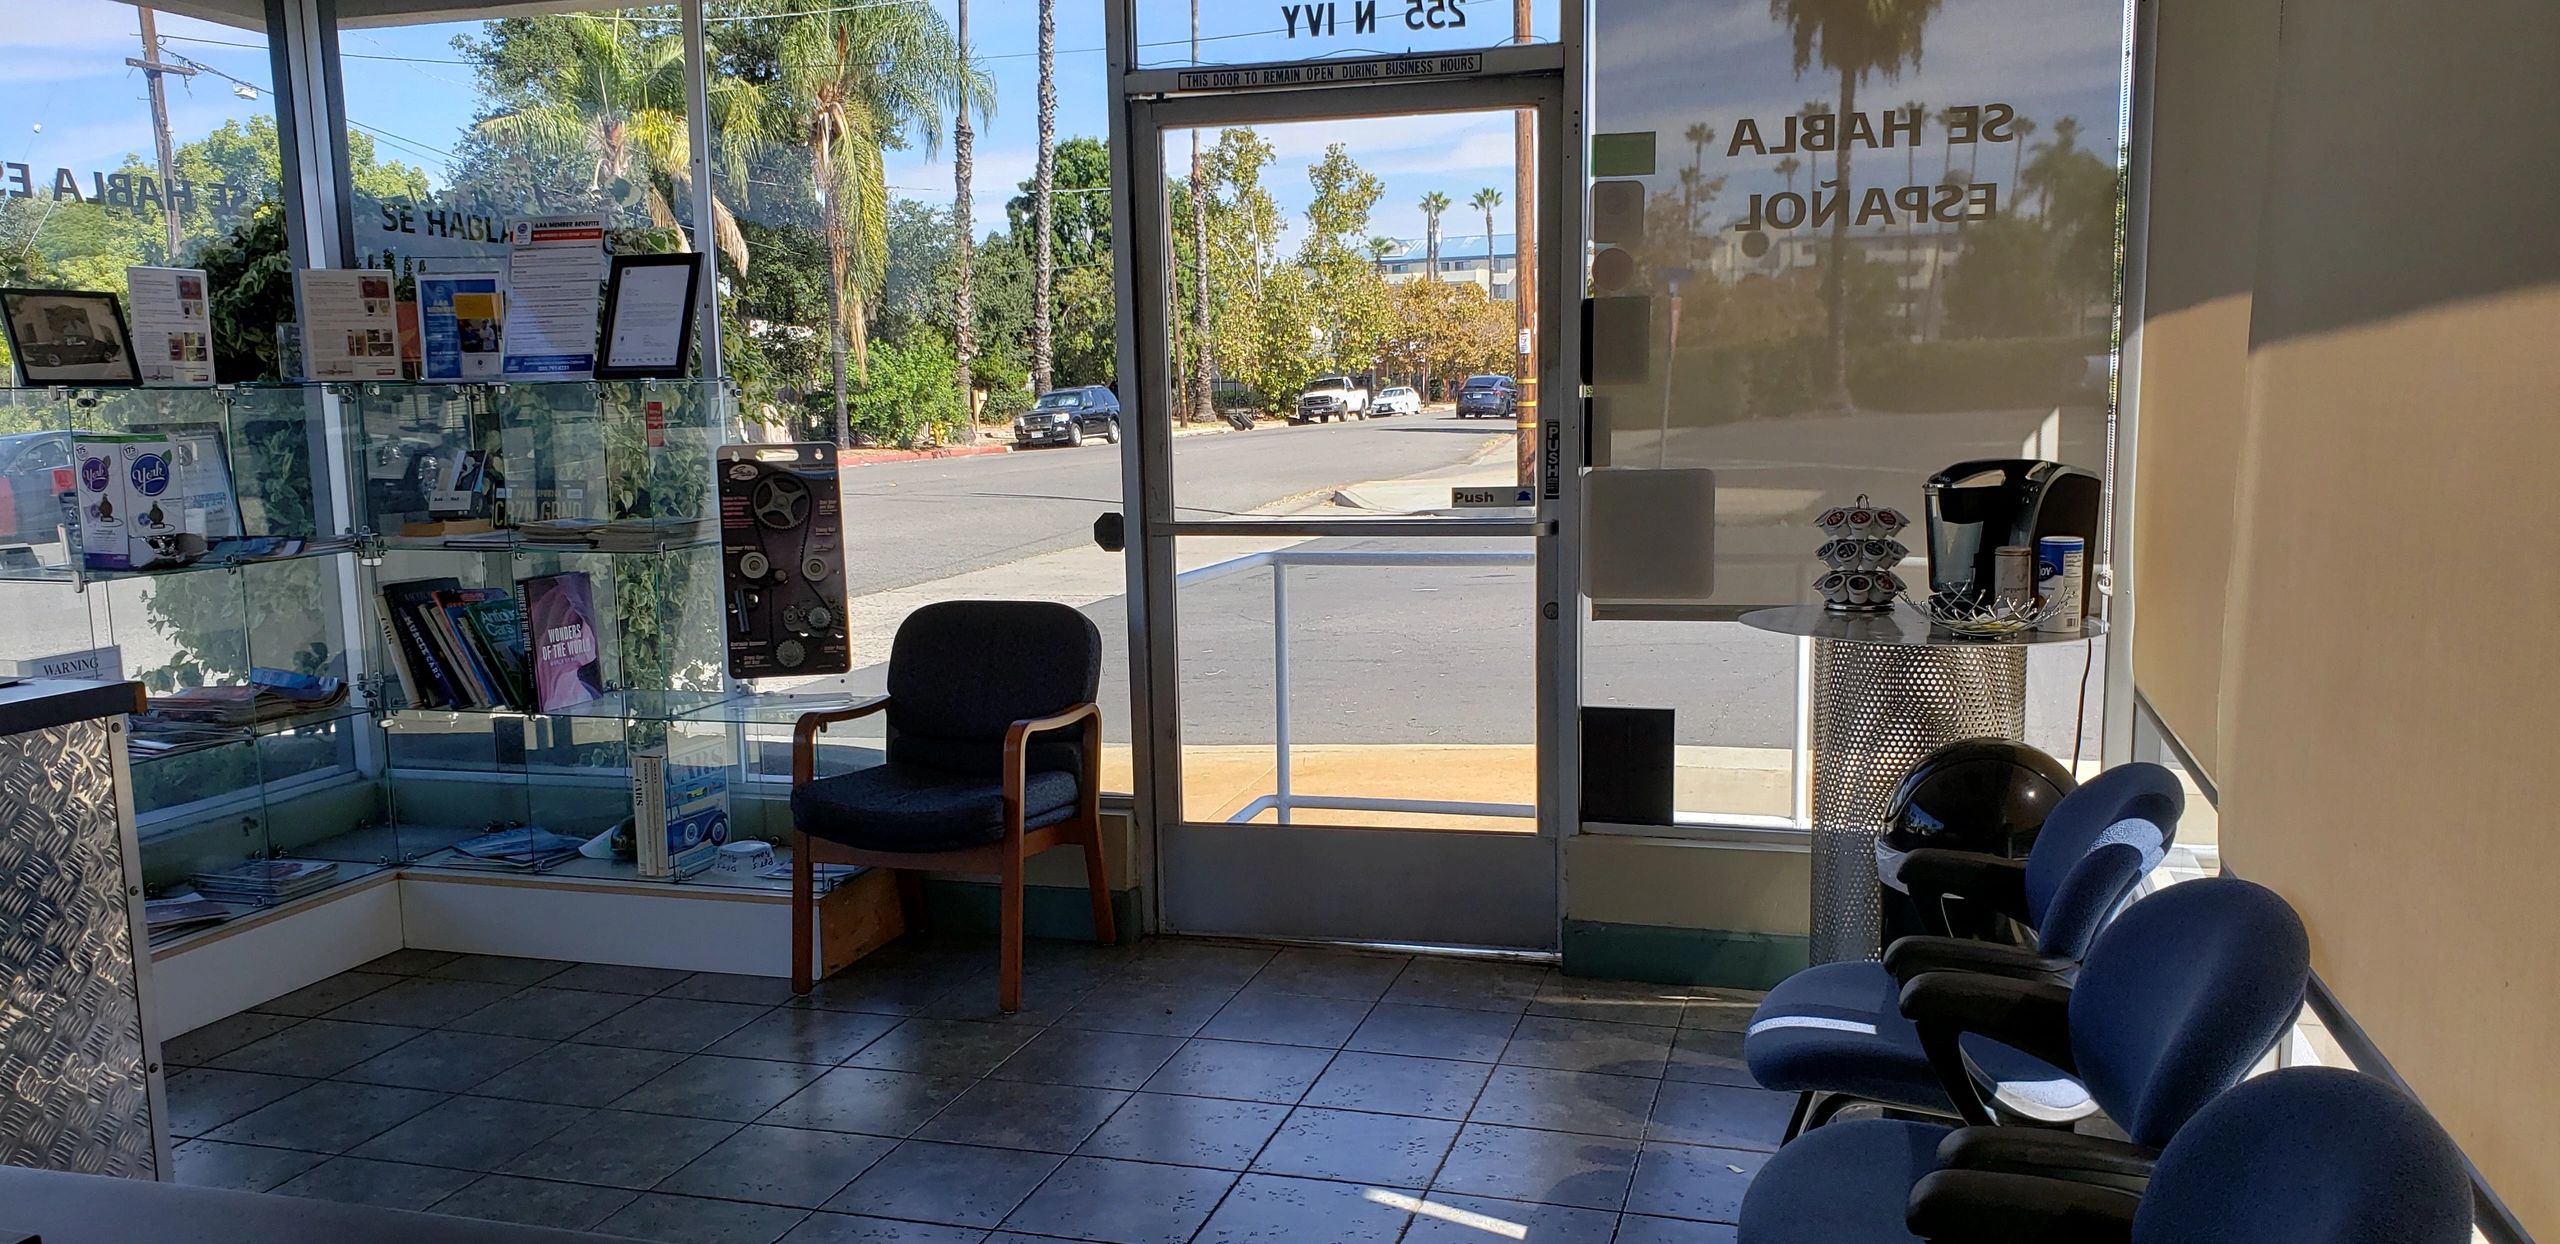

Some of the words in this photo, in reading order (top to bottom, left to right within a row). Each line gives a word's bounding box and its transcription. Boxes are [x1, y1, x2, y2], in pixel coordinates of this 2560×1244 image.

[1185, 74, 1209, 87] THIS
[1213, 73, 1240, 87] DOOR
[1244, 72, 1258, 86] TO
[1263, 69, 1300, 84] REMAIN
[1306, 66, 1334, 81] OPEN
[1342, 64, 1378, 78] DURING
[1385, 60, 1434, 76] BUSINESS
[1440, 57, 1475, 73] HOURS
[1547, 426, 1559, 477] PUSH
[132, 461, 165, 495] York
[1453, 491, 1494, 504] Push
[548, 623, 582, 643] WONDERS
[542, 646, 552, 661] OF
[554, 644, 567, 659] THE
[43, 656, 99, 677] WARNING
[634, 778, 643, 807] CARS
